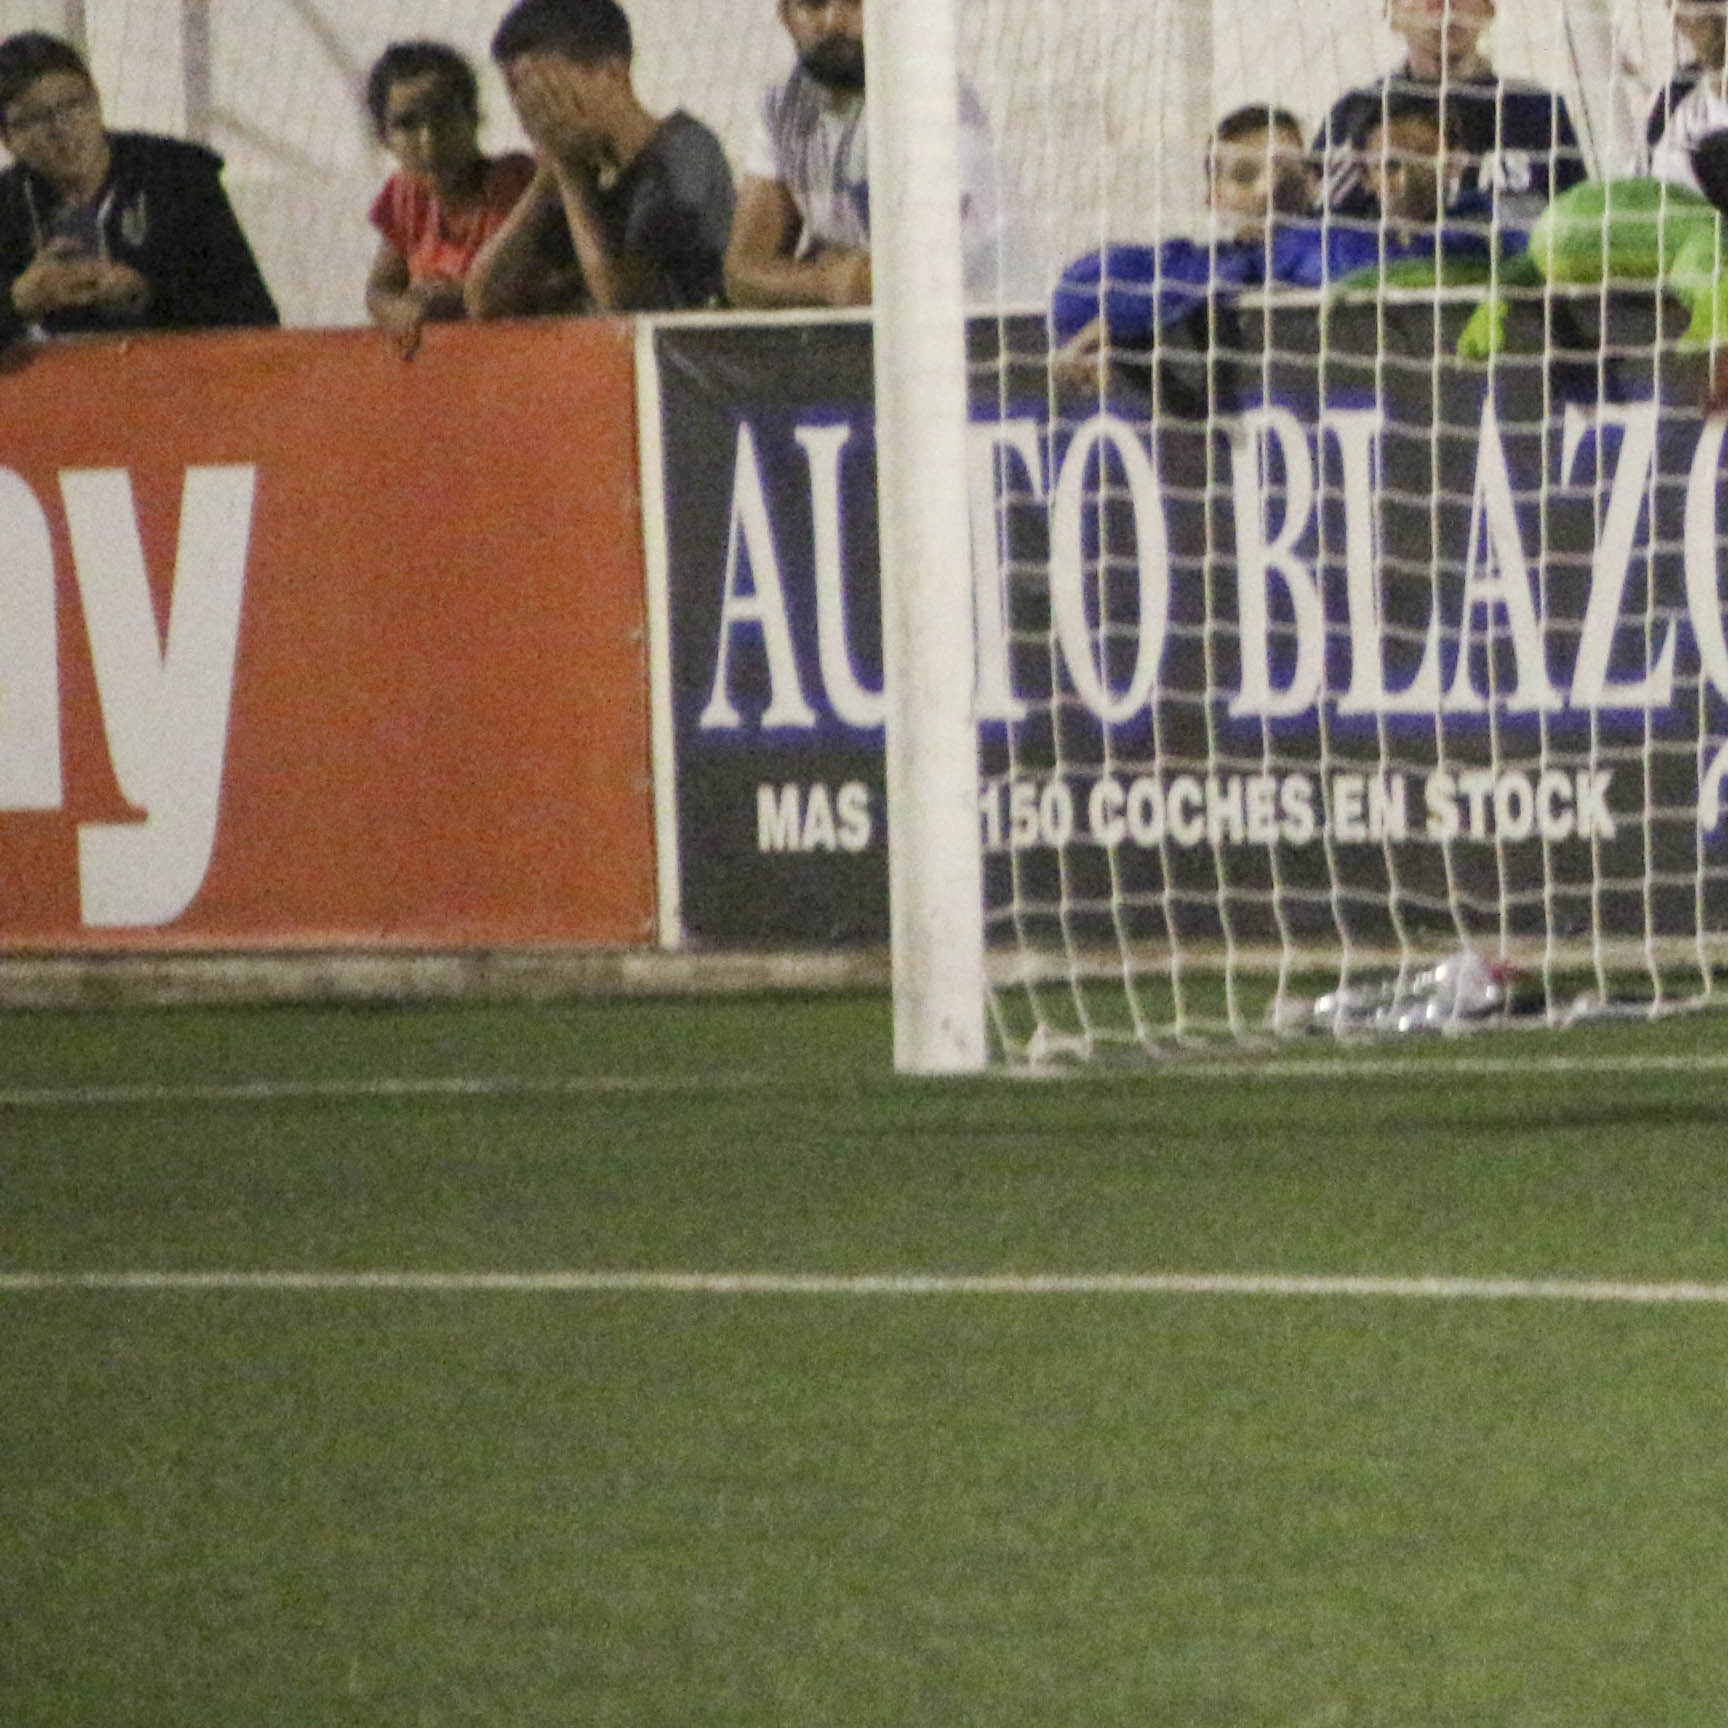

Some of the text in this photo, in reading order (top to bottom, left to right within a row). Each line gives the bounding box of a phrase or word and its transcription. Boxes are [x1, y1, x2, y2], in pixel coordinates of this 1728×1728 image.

[700, 402, 1170, 728] AUTO
[757, 770, 1617, 853] MAS 150 COCHES EN STOCK
